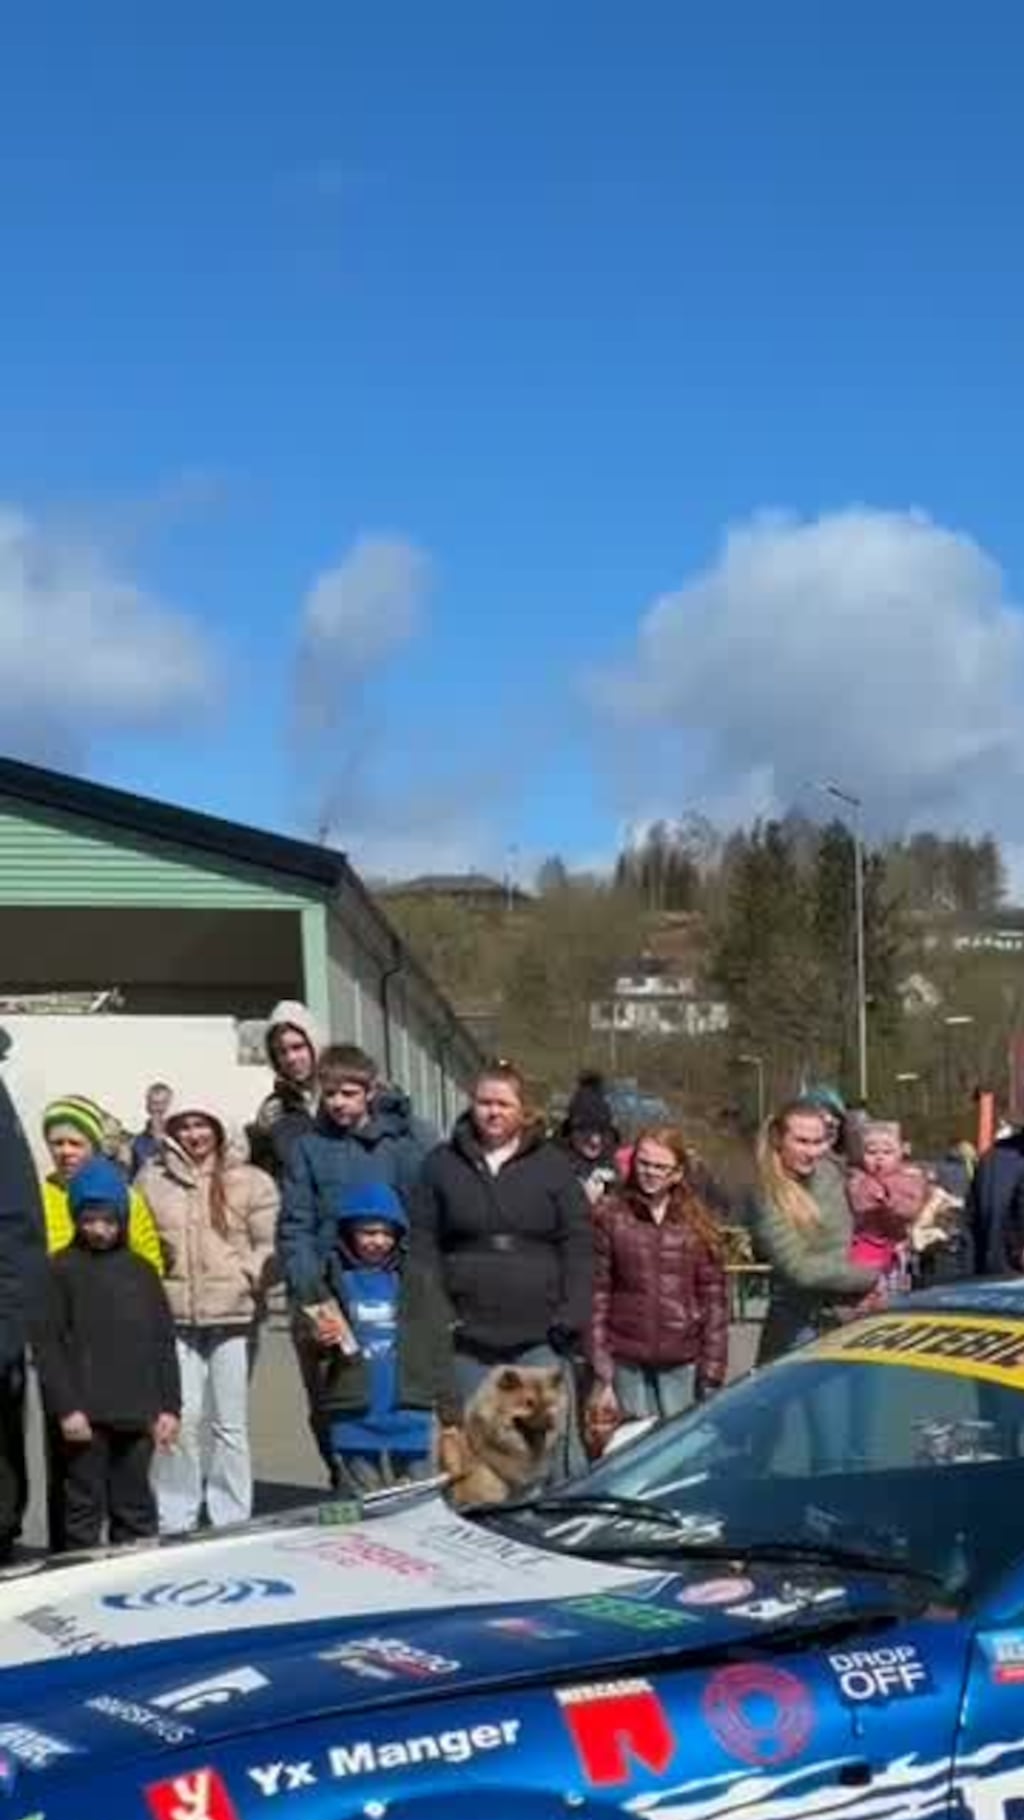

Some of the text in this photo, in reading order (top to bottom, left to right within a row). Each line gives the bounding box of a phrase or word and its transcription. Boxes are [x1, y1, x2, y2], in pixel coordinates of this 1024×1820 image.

[829, 1646, 916, 1672] DROP
[840, 1663, 926, 1699] OFF
[248, 1719, 522, 1797] Yx Manger
